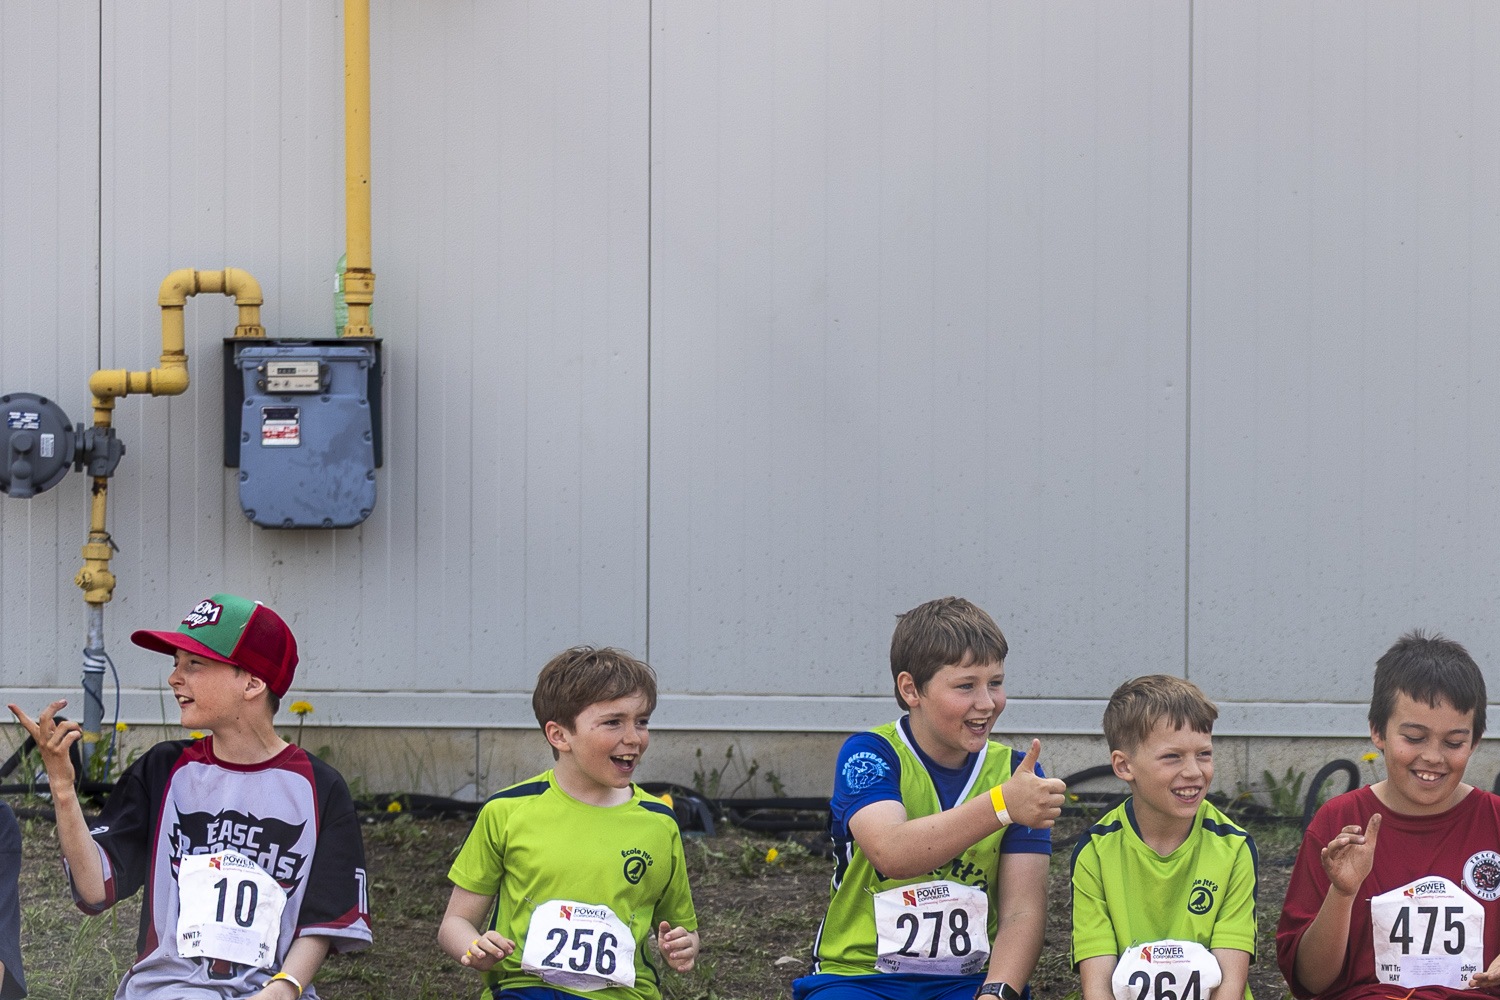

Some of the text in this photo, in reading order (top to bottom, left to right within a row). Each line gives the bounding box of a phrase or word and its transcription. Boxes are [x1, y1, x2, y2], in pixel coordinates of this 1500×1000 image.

[207, 818, 263, 849] ÉASC
[916, 886, 950, 899] POWER
[1415, 882, 1446, 895] POWER
[214, 877, 259, 928] 10
[574, 908, 607, 919] POWER
[896, 908, 972, 959] 278
[1389, 906, 1466, 956] 475
[541, 928, 618, 976] 256
[1153, 947, 1184, 955] POWER
[1381, 964, 1393, 972] NWT
